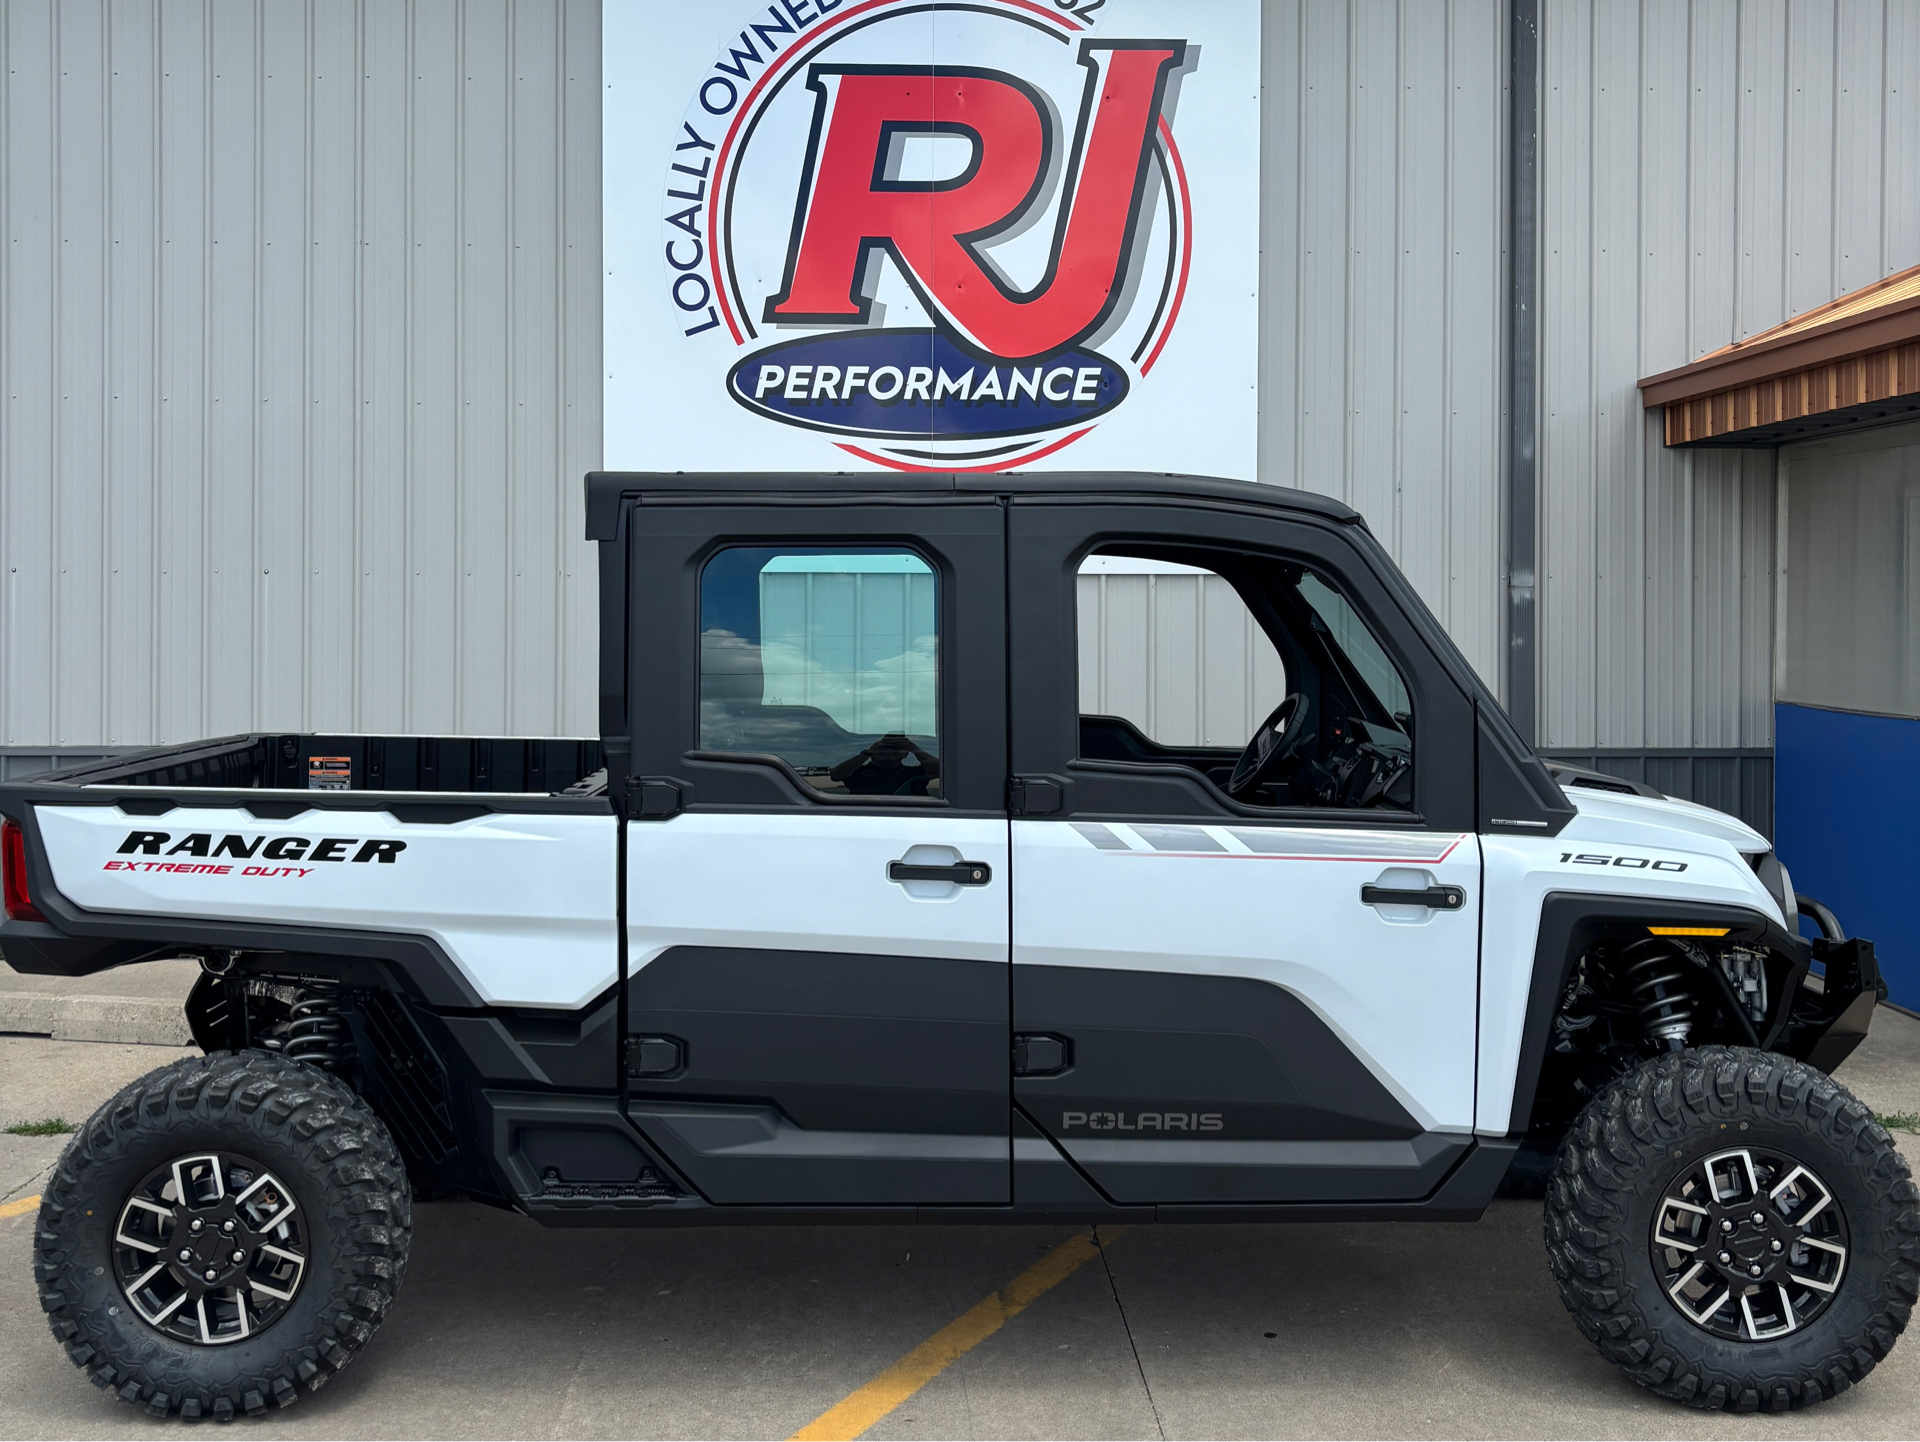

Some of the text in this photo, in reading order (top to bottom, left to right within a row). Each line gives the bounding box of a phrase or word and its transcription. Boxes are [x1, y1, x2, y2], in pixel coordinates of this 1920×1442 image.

[763, 39, 1189, 363] RJ
[665, 121, 721, 337] LOCALLY
[755, 365, 1103, 403] PERFORMANCE
[115, 831, 407, 863] RANGER
[1560, 853, 1688, 872] 1500
[103, 861, 316, 878] EXTREME DUTY
[1063, 1112, 1224, 1131] POLARIS
